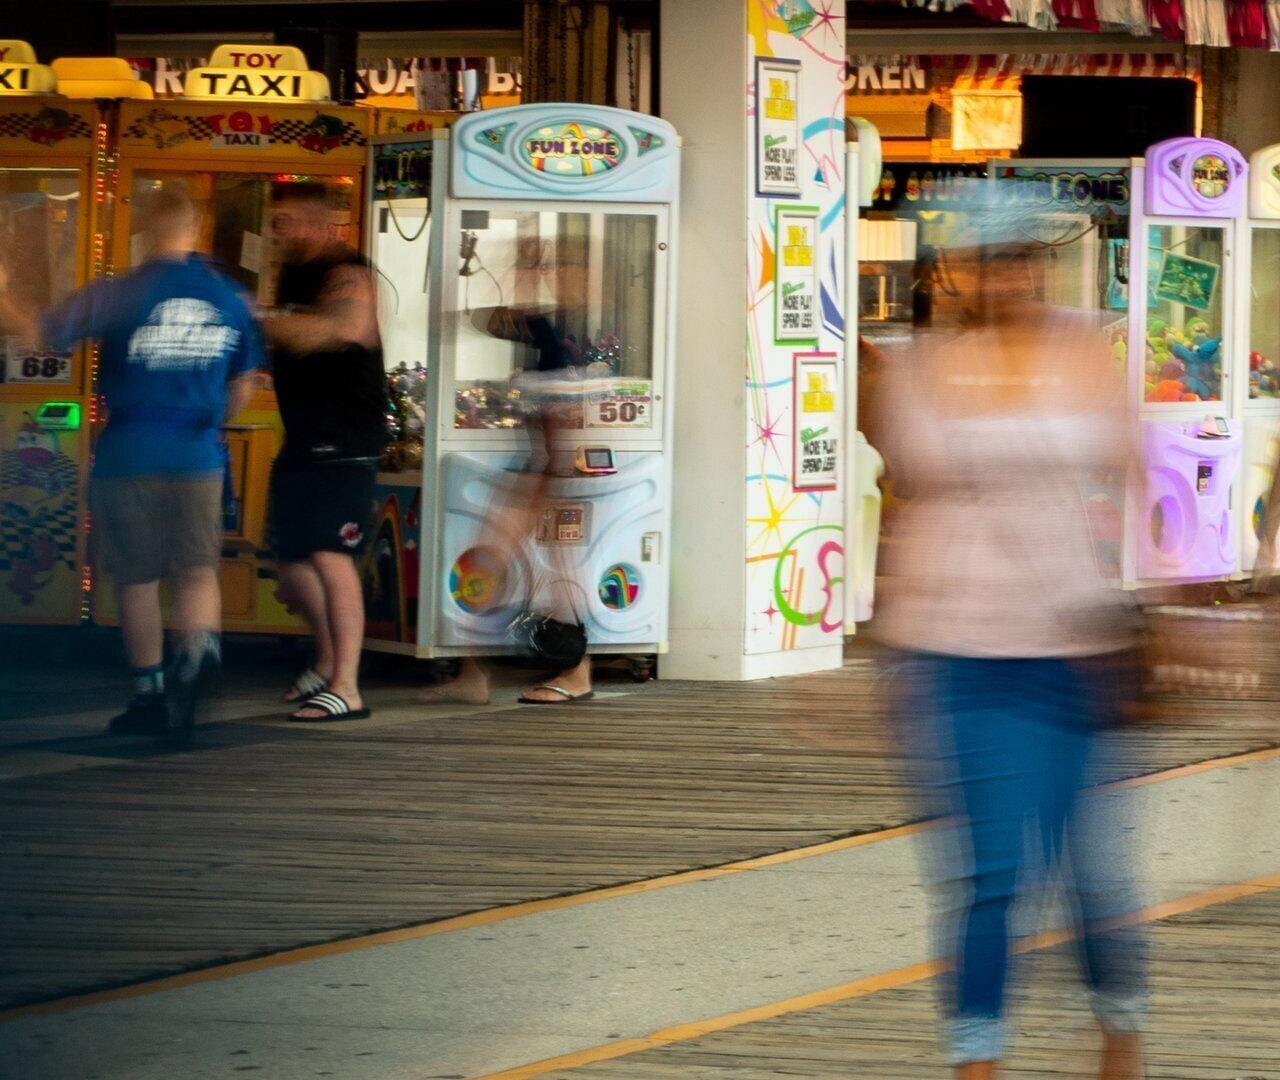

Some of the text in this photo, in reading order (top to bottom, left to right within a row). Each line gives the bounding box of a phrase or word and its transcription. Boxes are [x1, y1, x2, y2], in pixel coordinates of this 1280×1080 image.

[230, 53, 283, 69] TOY
[201, 73, 302, 97] TAXI
[223, 133, 261, 146] TAXI
[529, 139, 618, 158] FUN ZONE
[600, 402, 645, 423] 50¢
